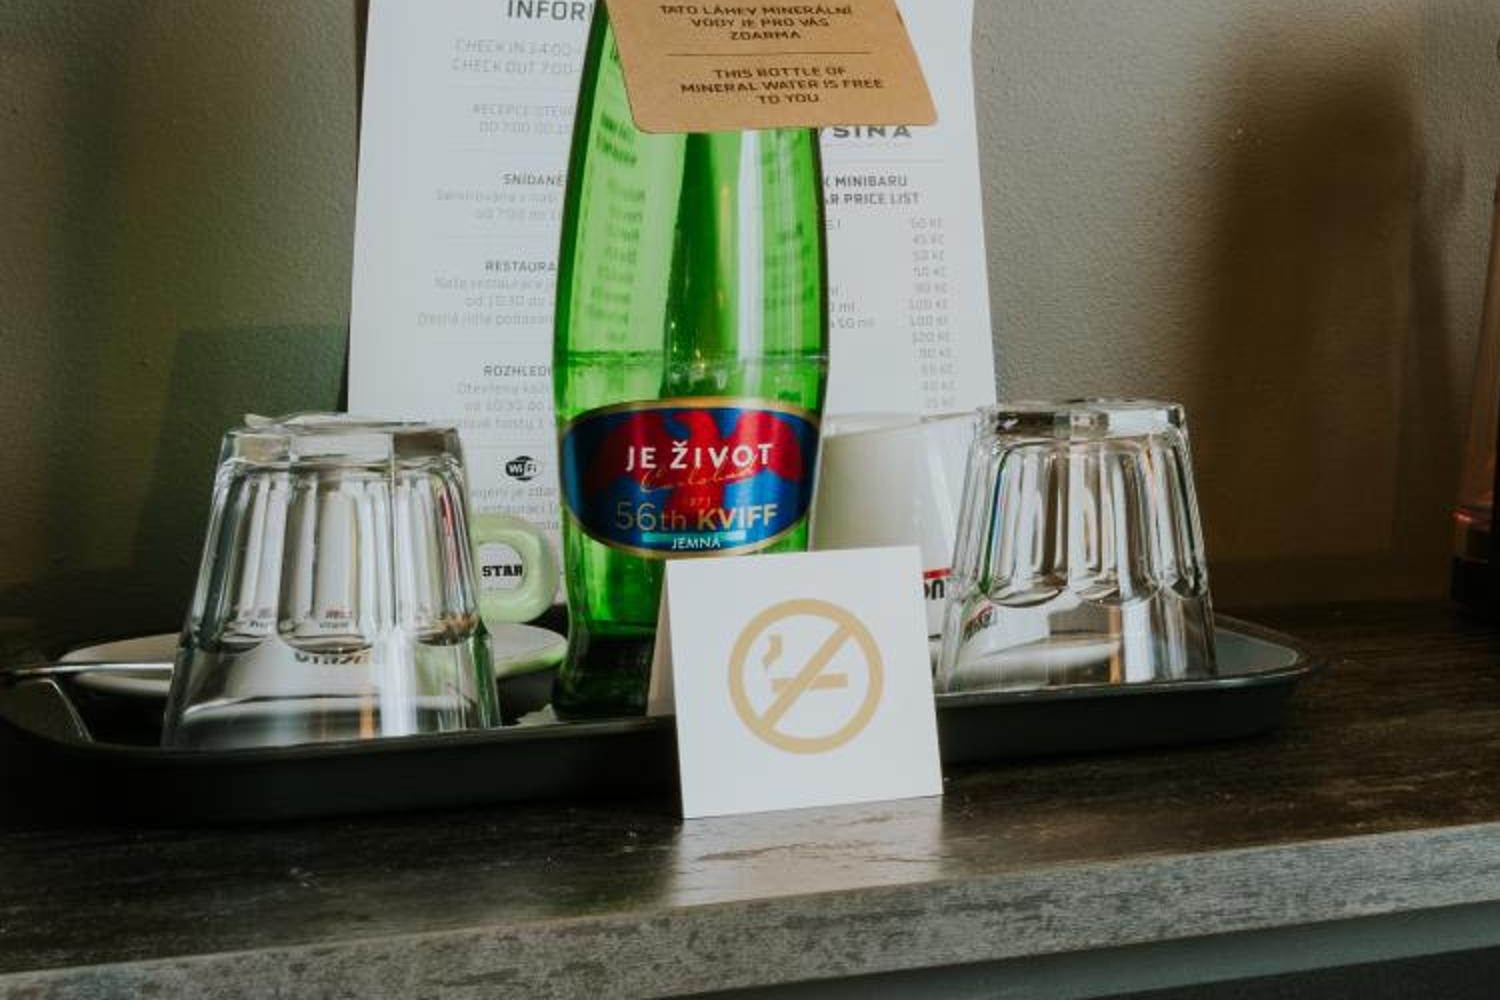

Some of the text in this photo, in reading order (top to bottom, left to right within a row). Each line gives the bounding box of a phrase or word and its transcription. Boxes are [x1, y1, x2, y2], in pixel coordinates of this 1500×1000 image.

[660, 5, 698, 16] TATO
[703, 3, 757, 16] LÁHEV
[691, 15, 829, 28] VODY JE PRO VÁS
[730, 30, 801, 41] ZDARMA
[713, 66, 846, 79] THIS BOTTLE OF
[681, 78, 884, 94] MINERAL WATER IS FREE
[758, 94, 820, 105] TO YOU
[835, 175, 908, 187] MINIBARU
[843, 192, 885, 205] PRICE
[890, 192, 920, 205] LIST
[485, 261, 556, 272] RESTAURA
[626, 440, 774, 471] JE ŽIVOT
[615, 502, 778, 531] 56th KVIFF
